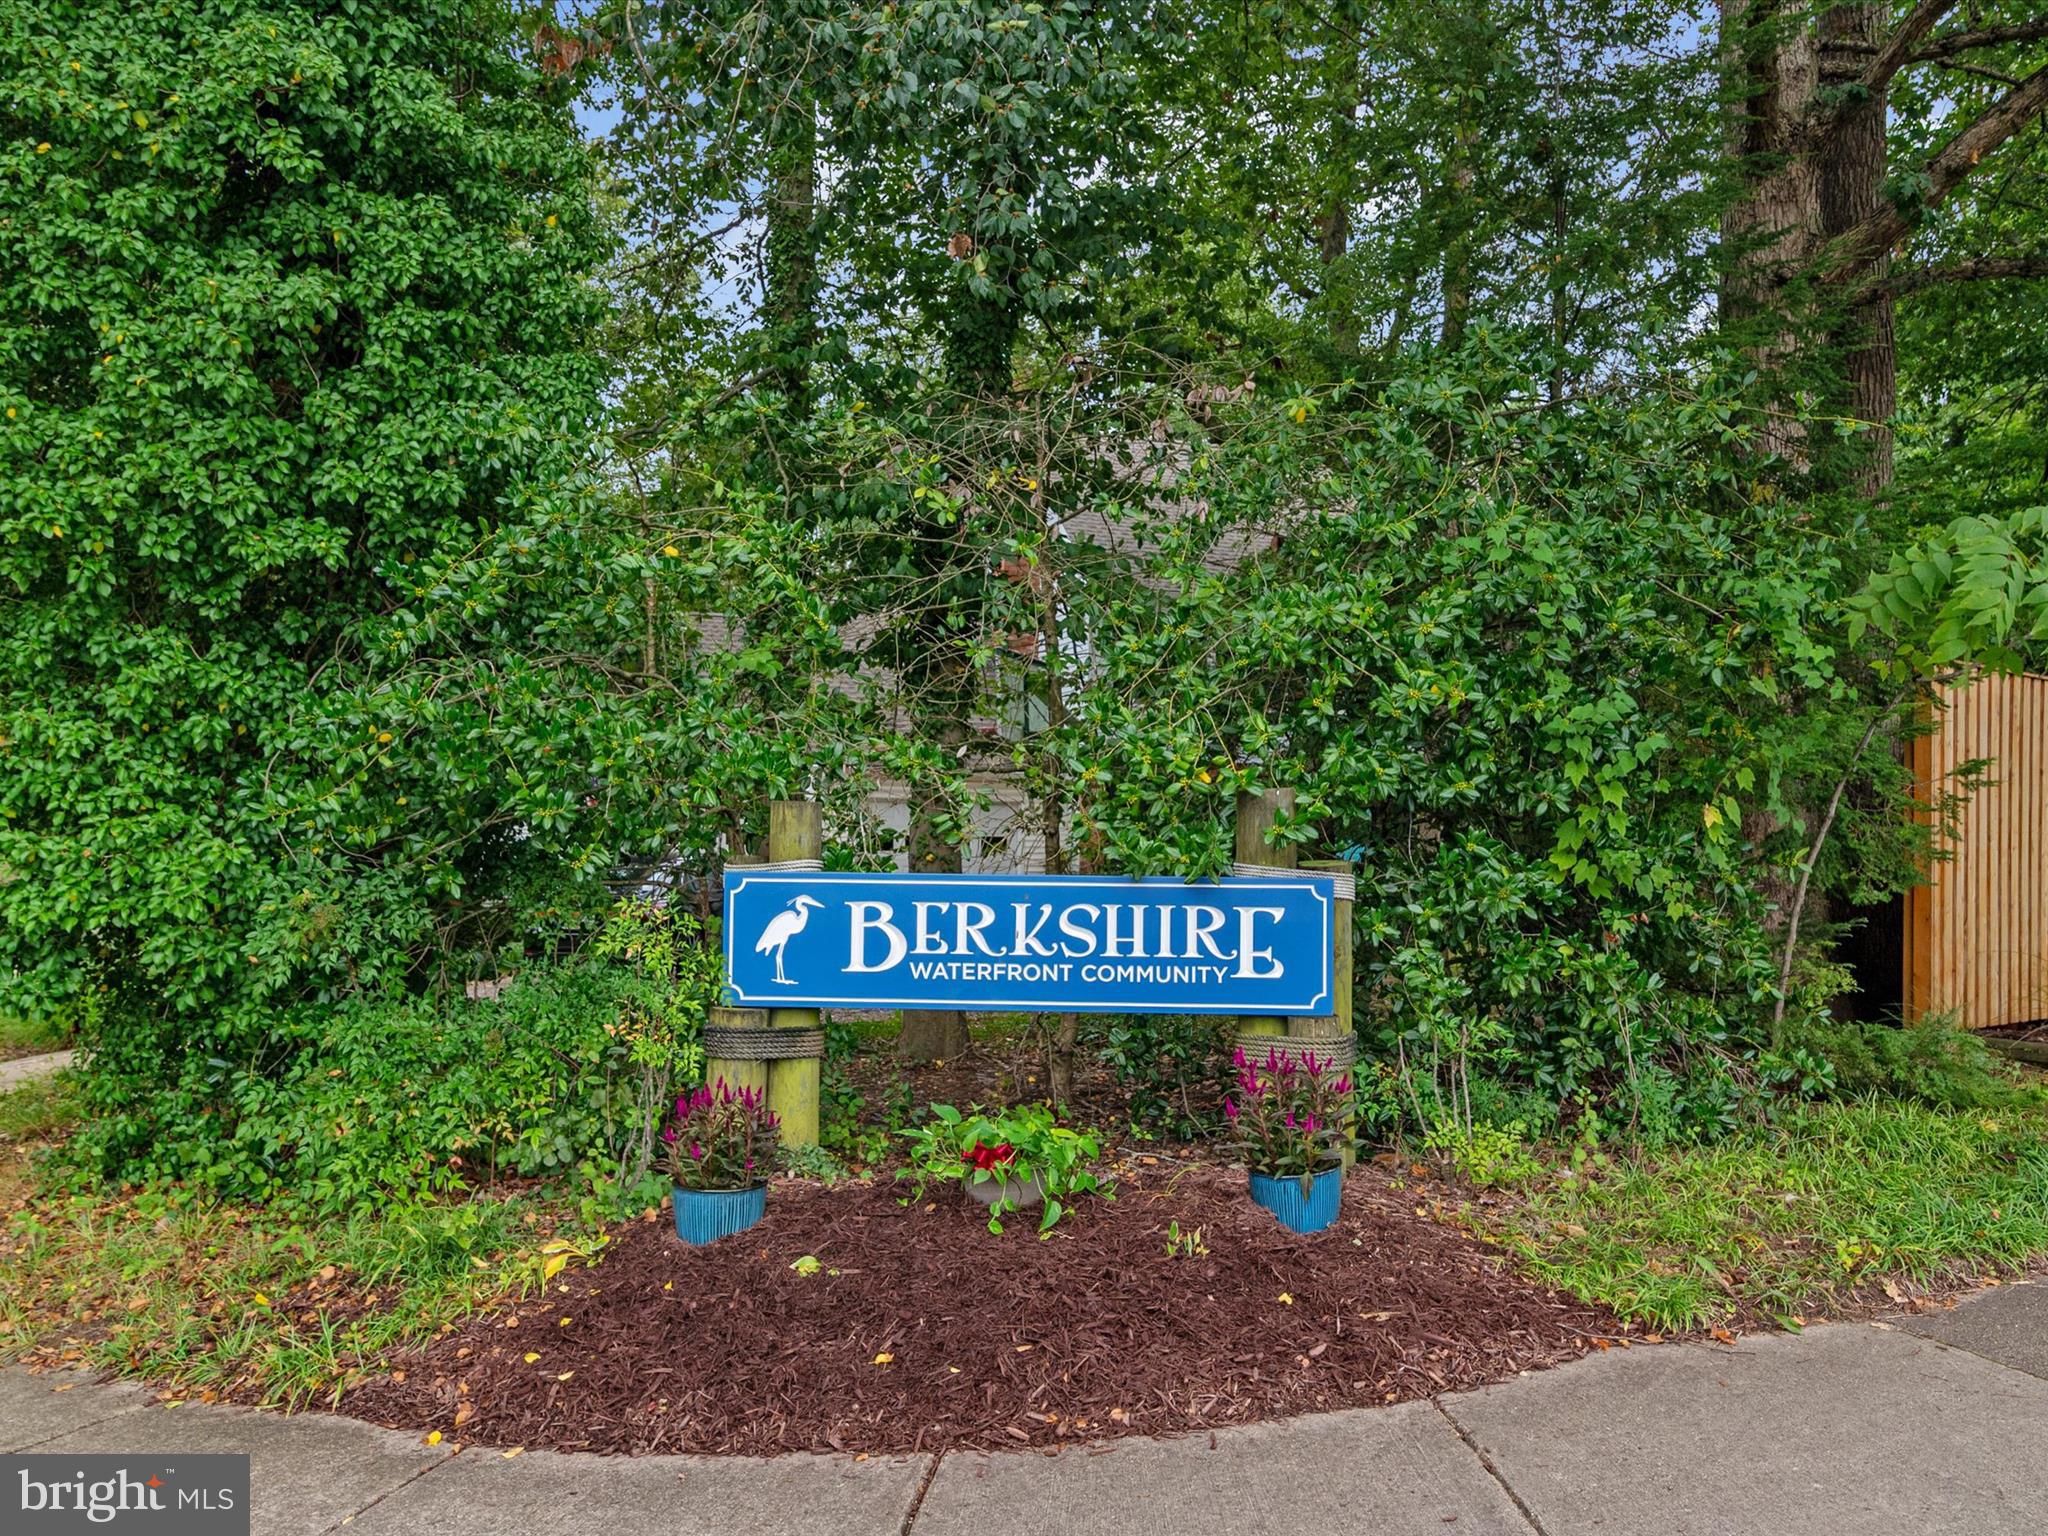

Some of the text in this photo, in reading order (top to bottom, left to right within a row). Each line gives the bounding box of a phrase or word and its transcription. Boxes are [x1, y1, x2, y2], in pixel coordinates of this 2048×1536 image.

[841, 900, 1286, 980] BERKSHIRE
[909, 962, 1229, 985] WATERFRONT COMMUNITY
